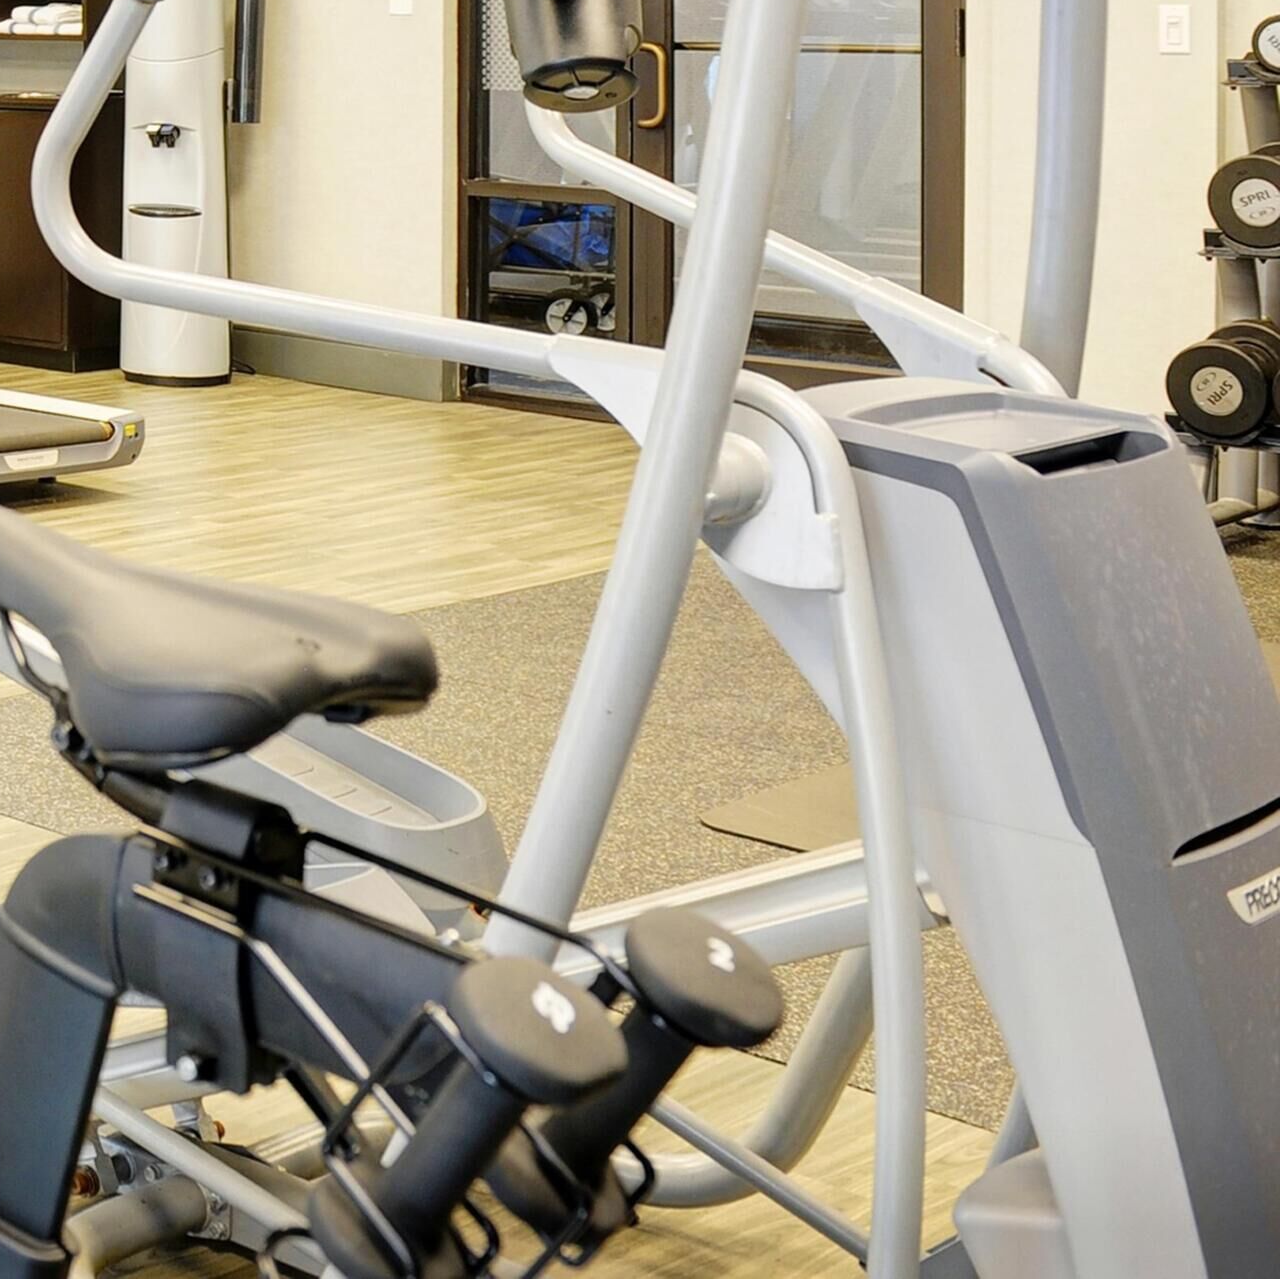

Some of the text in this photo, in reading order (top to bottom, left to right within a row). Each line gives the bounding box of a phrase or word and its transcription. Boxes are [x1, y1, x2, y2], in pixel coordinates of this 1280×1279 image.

[1239, 190, 1272, 207] SPRI
[1206, 380, 1234, 406] SPRI
[1244, 876, 1280, 917] PREC
